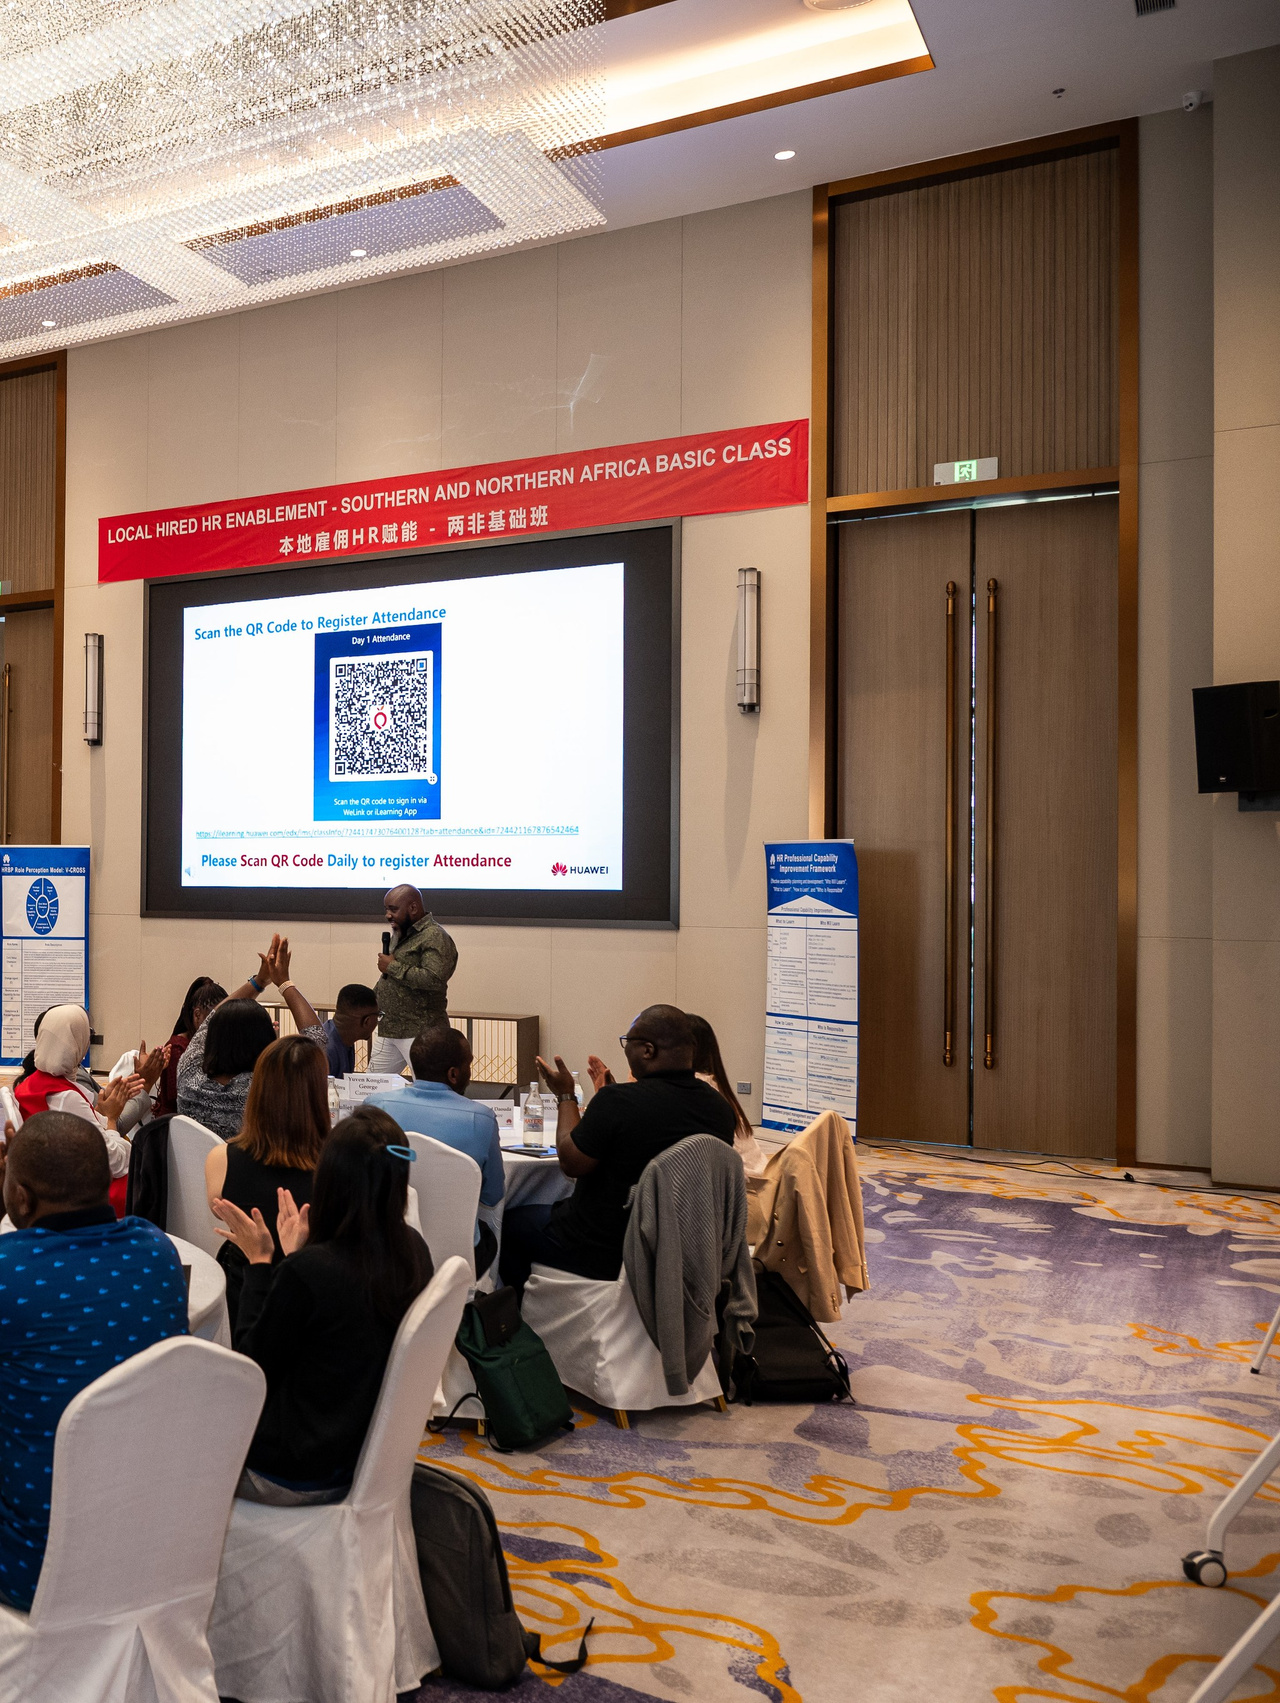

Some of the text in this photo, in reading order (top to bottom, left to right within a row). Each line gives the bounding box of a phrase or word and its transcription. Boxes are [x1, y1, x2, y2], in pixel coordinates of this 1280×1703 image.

[108, 525, 152, 544] LOCAL
[156, 518, 198, 537] HIRED
[202, 515, 222, 532] HR
[226, 500, 328, 529] ENABLEMENT
[340, 486, 429, 514] SOUTHERN
[434, 481, 470, 501] AND
[475, 467, 574, 497] NORTHERN
[580, 457, 650, 483] AFRICA
[656, 447, 716, 473] BASIC
[722, 437, 792, 463] CLASS
[279, 520, 418, 557] 本地雇佣HR赋能
[447, 505, 549, 537] 两非基础班
[194, 607, 447, 640] Scan the QR Code to Register Attendance
[352, 632, 411, 645] Day 1 Attendance
[333, 796, 428, 806] Scan the QR code to sign in via
[343, 808, 365, 816] WeLink
[374, 808, 402, 817] iLearning
[404, 807, 418, 816] App
[201, 853, 512, 870] Please Scan QR Code Daily to register Attendance
[777, 853, 838, 864] HR Professional Capability
[25, 866, 49, 874] Perception
[570, 866, 609, 874] HUAWEI
[779, 864, 836, 874] Improvement Framework
